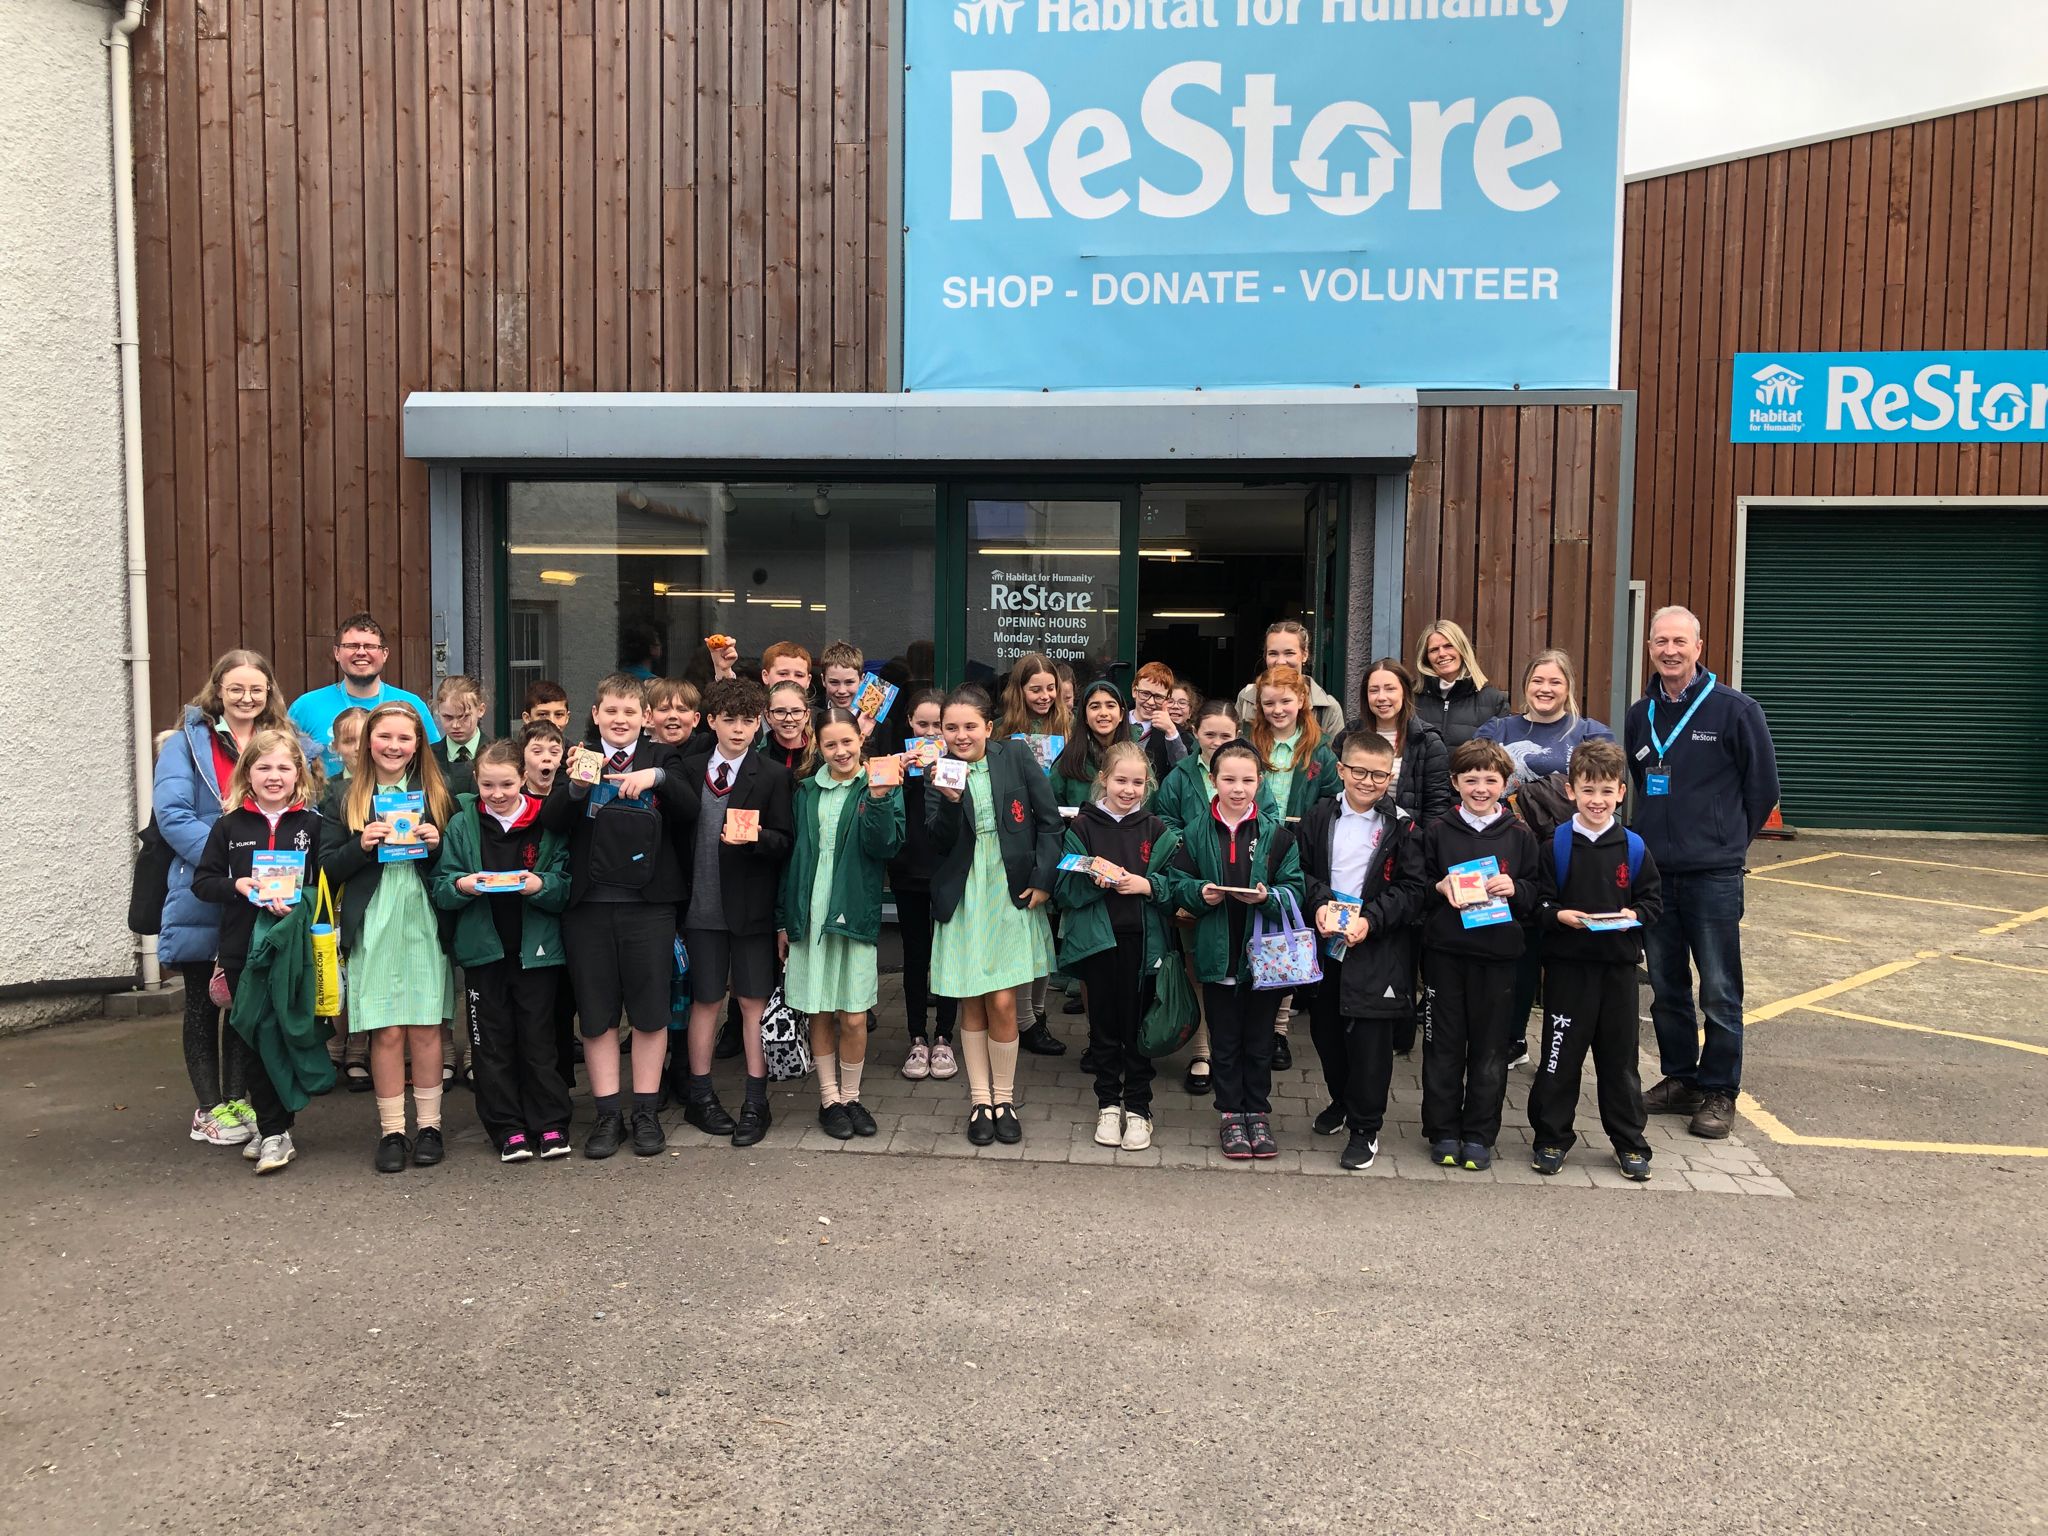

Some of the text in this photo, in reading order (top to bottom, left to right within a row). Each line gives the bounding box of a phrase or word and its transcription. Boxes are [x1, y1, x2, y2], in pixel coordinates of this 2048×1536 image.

[1037, 0, 1219, 33] Habitat
[1236, 0, 1300, 26] for
[949, 60, 1563, 221] ReStore
[942, 274, 1054, 309] SHOP
[1092, 269, 1260, 307] DONATE
[1300, 266, 1559, 302] VOLUNTEER
[1750, 409, 1803, 423] Habitat
[1750, 423, 1761, 432] for
[1006, 573, 1093, 584] Habitat for Humanity
[990, 584, 1092, 611] ReStore
[997, 616, 1087, 629] OPENING HOURS
[993, 632, 1035, 646] Monday
[1044, 632, 1090, 647] Saturday
[1046, 648, 1085, 662] 5:00pm
[1691, 733, 1717, 742] ReStore
[470, 1004, 481, 1046] KUKRI
[1425, 1001, 1433, 1042] KUKRI
[1546, 1030, 1564, 1074] KUKRI
